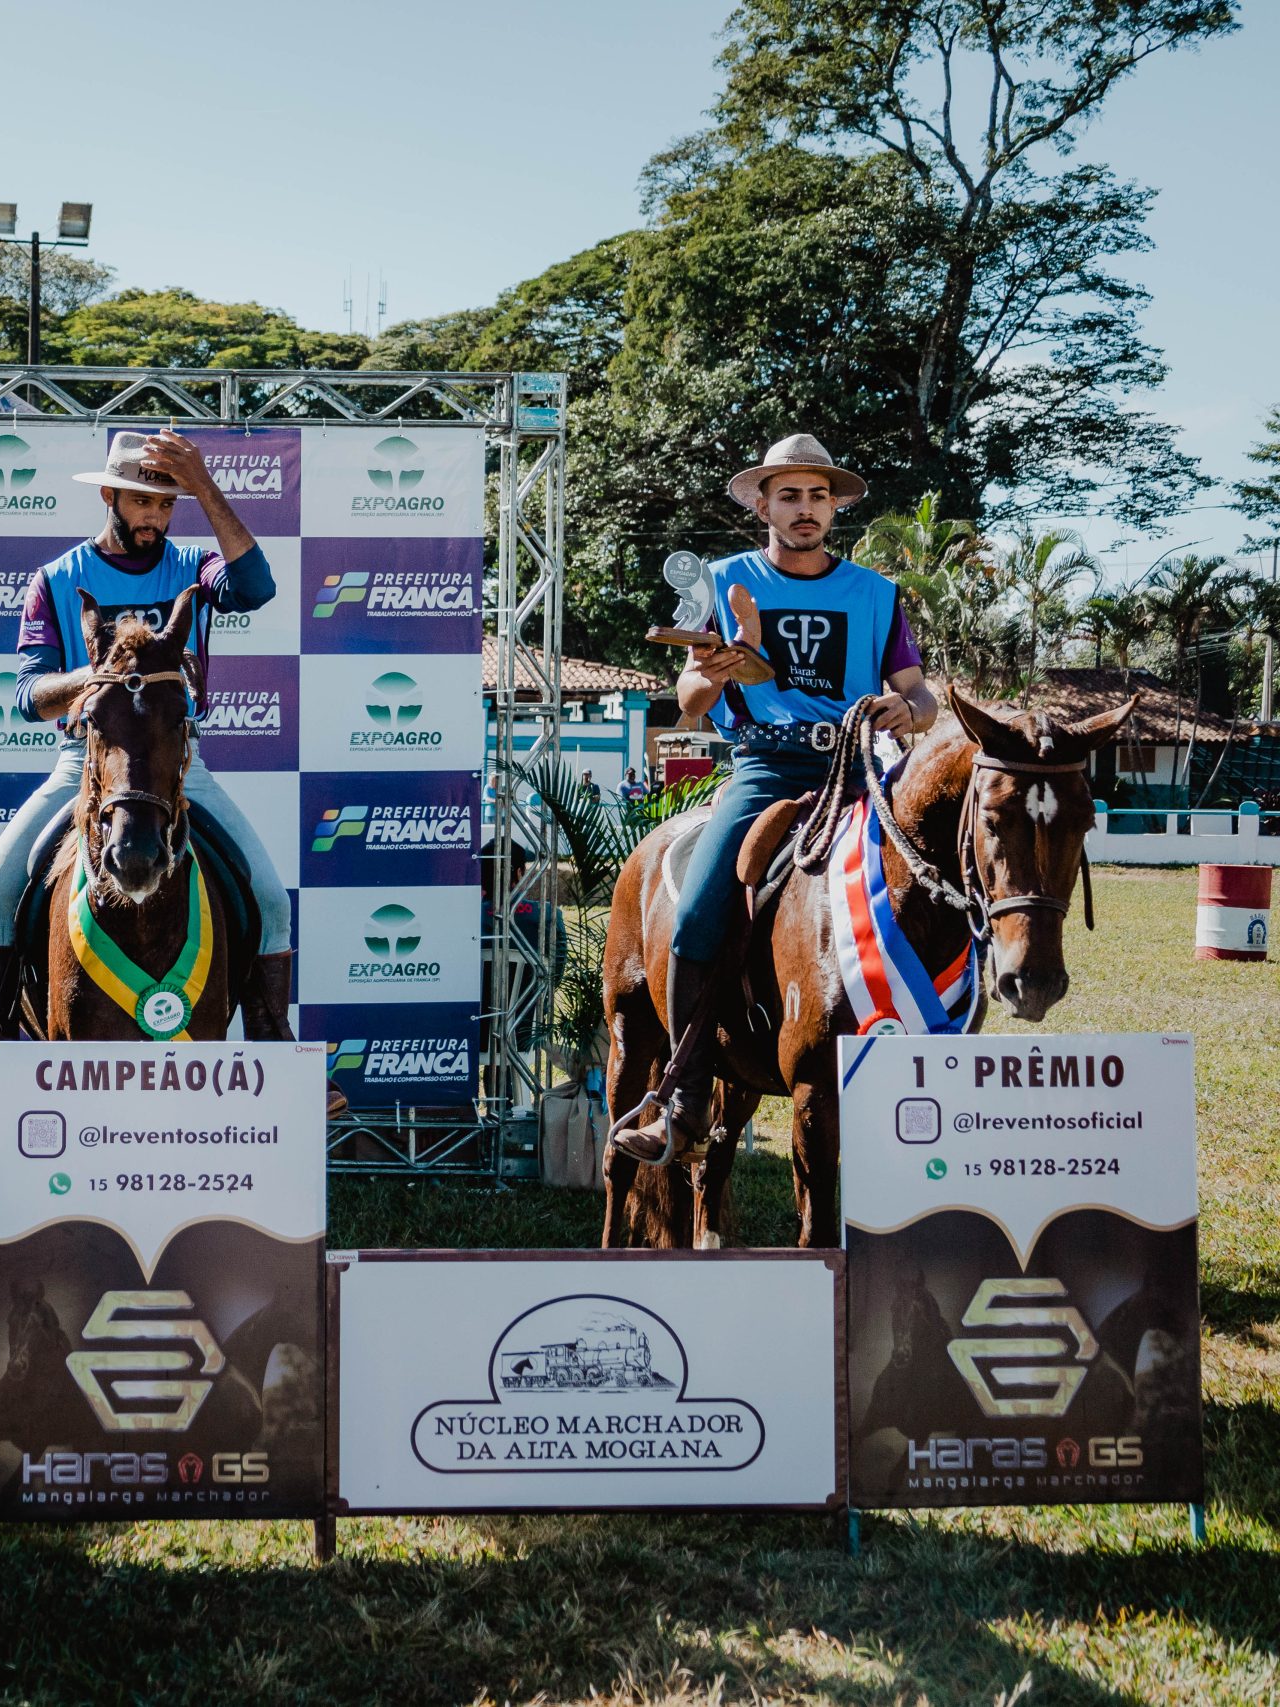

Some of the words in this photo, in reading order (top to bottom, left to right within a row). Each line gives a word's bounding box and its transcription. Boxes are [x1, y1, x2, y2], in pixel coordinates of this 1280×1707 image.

[205, 455, 281, 467] EFEITURA
[208, 468, 282, 492] ANCA
[351, 497, 445, 511] EXPOAGRO
[373, 573, 472, 585] PREFEITURA
[367, 586, 473, 609] FRANCA
[789, 665, 816, 676] Haras
[206, 692, 280, 704] EFEITURA
[350, 731, 443, 746] EXPOAGRO
[371, 806, 471, 819] PREFEITURA
[365, 819, 472, 842] FRANCA
[348, 962, 441, 977] EXPOAGRO
[370, 1038, 469, 1052] PREFEITURA
[364, 1052, 469, 1076] FRANCA
[975, 1046, 1124, 1088] PRÊMIO
[36, 1051, 265, 1097] CAMPEÃO(Ã)
[953, 1111, 1142, 1133] @lreventosoficial
[79, 1126, 278, 1147] @lreventosoficial
[964, 1164, 982, 1176] 15
[989, 1158, 1120, 1176] 98128-2524
[89, 1178, 108, 1191] 15
[116, 1173, 253, 1191] 98128-2524
[435, 1412, 549, 1435] NÚCLEO
[556, 1415, 743, 1434] MARCHADOR
[457, 1442, 496, 1460] DA
[504, 1441, 577, 1460] ALTA
[585, 1440, 722, 1458] MOGIANA
[1088, 1436, 1144, 1468] GS
[212, 1452, 270, 1484] GS
[1037, 1474, 1144, 1487] Marchador
[157, 1490, 270, 1502] Marchador
